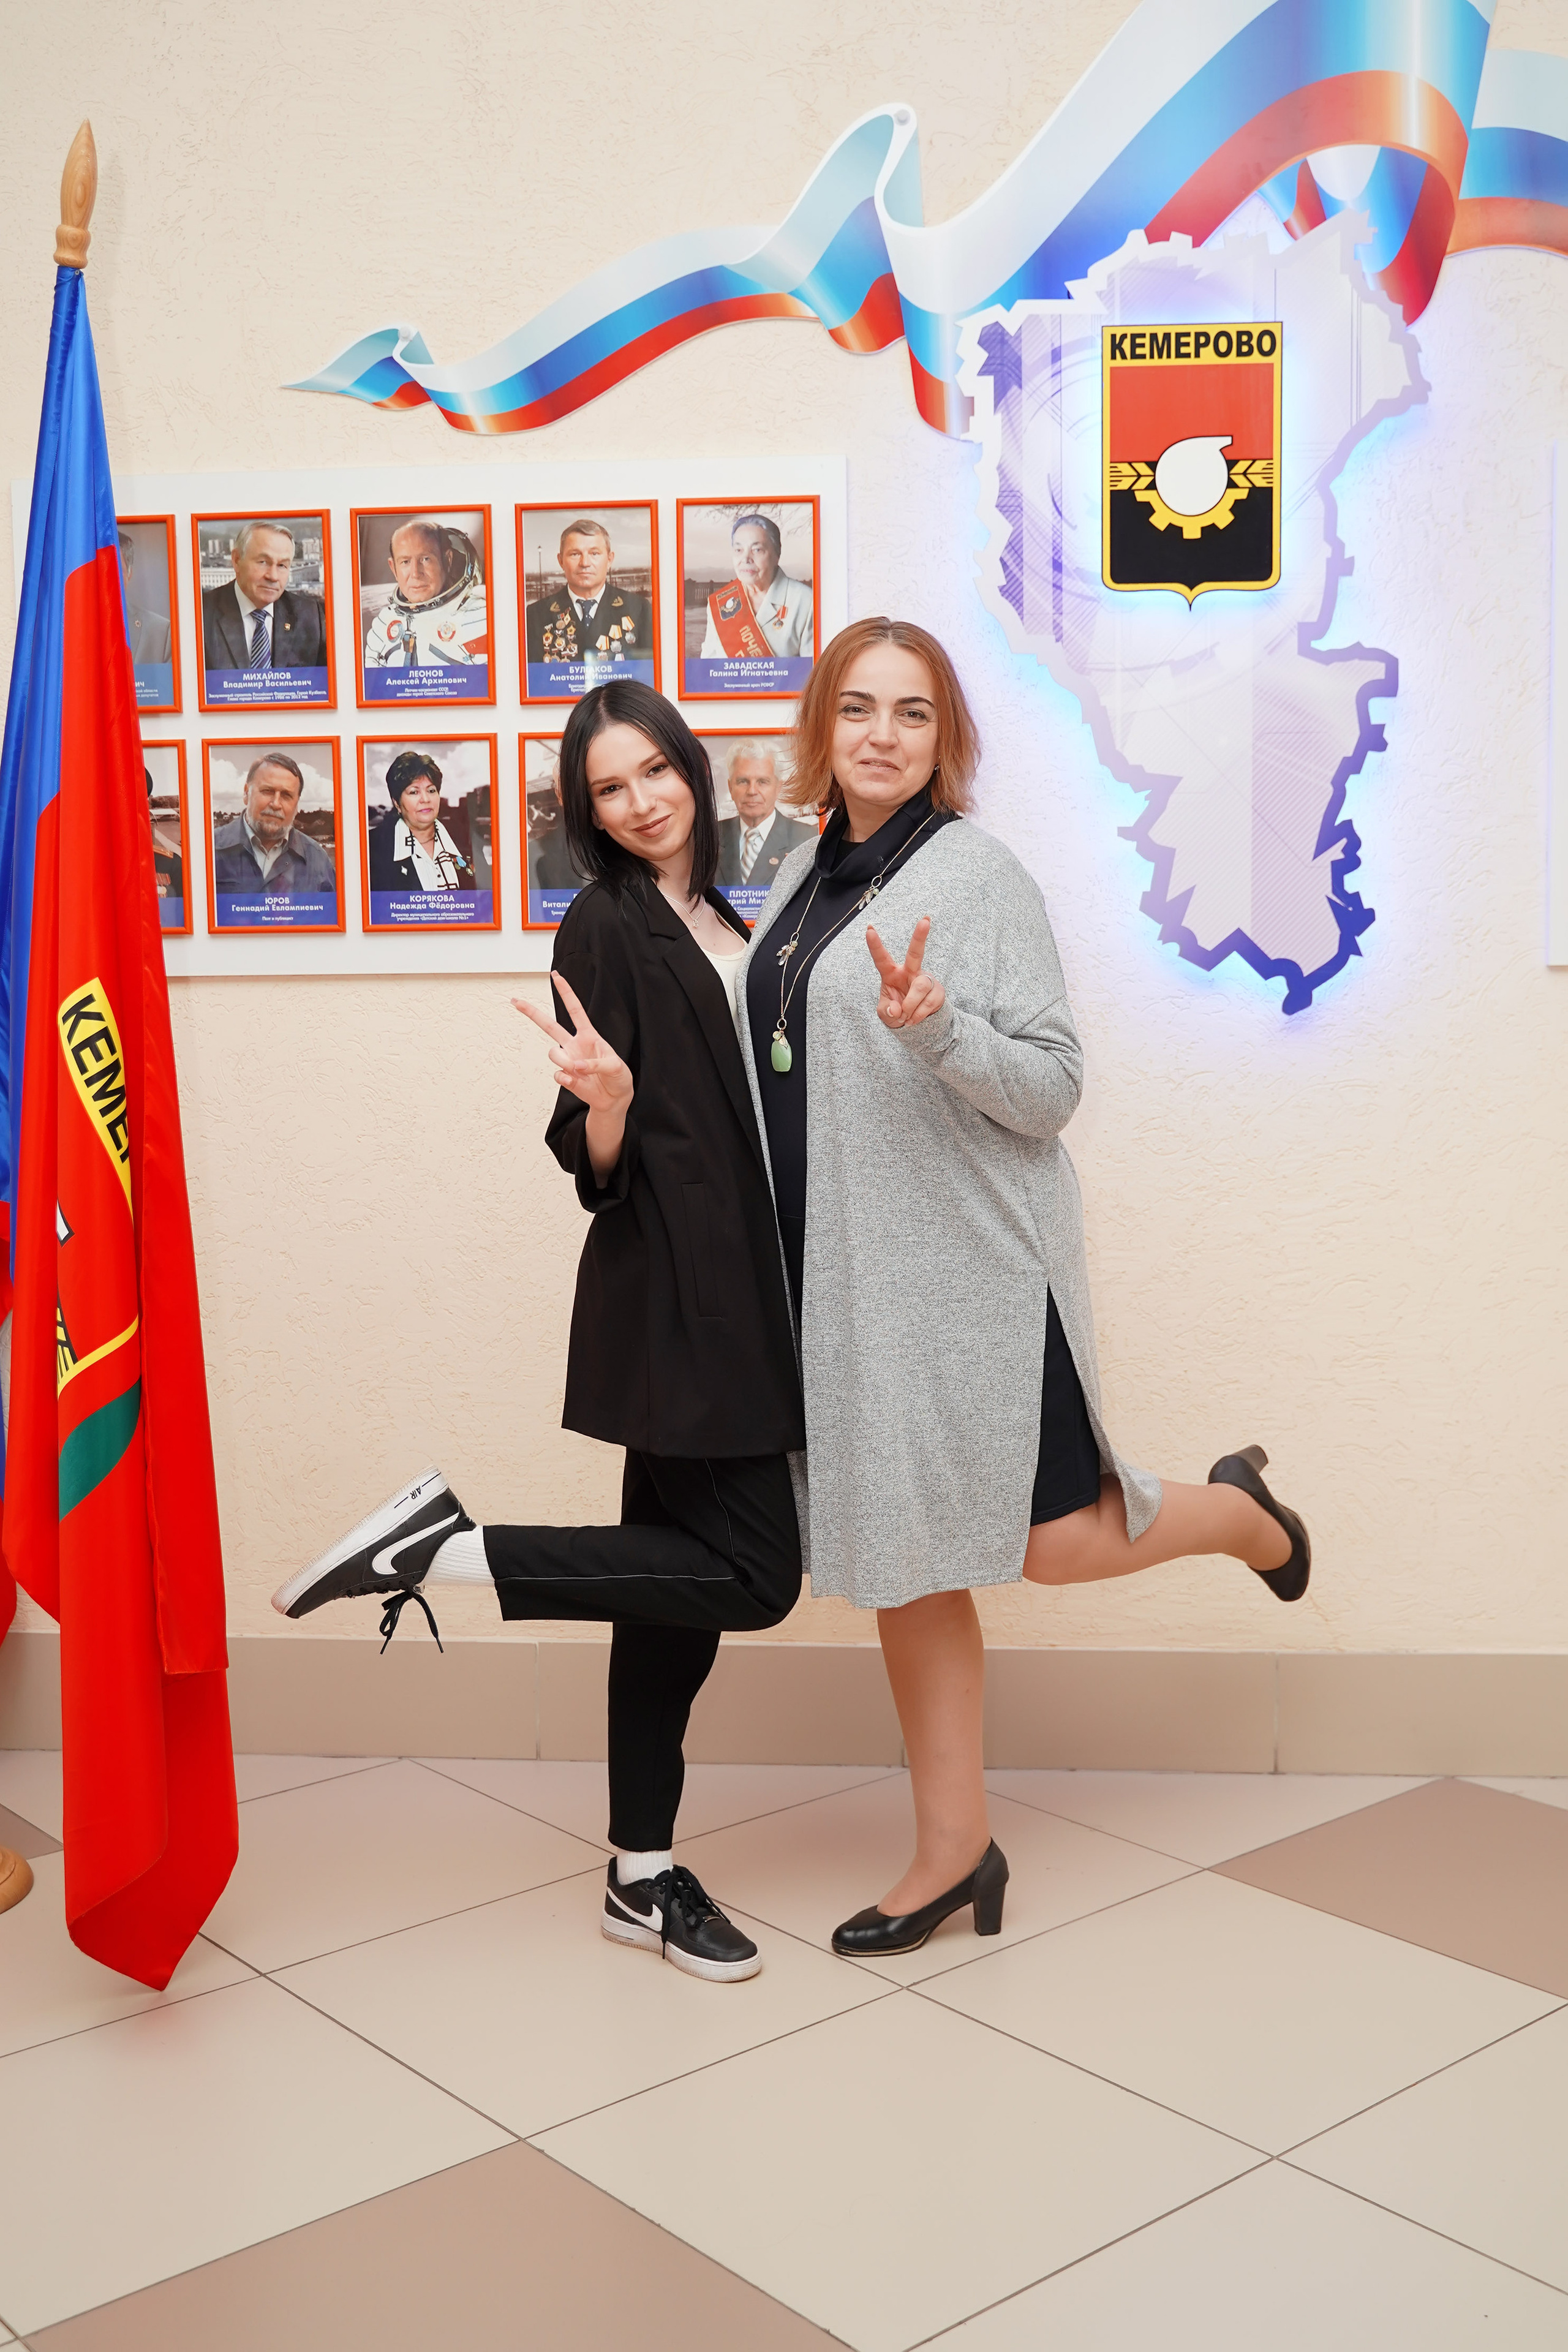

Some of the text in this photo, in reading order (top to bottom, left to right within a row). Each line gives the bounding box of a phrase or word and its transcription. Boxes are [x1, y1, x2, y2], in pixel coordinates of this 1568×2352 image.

[1110, 330, 1276, 360] КЕМЕРОВО
[723, 662, 774, 670] ЗАВАДСКАЯ
[243, 672, 291, 680] МИХАЙЛОВ
[421, 677, 467, 686] Архипович
[429, 902, 475, 910] Фёдоровна
[410, 1485, 421, 1499] AIR
